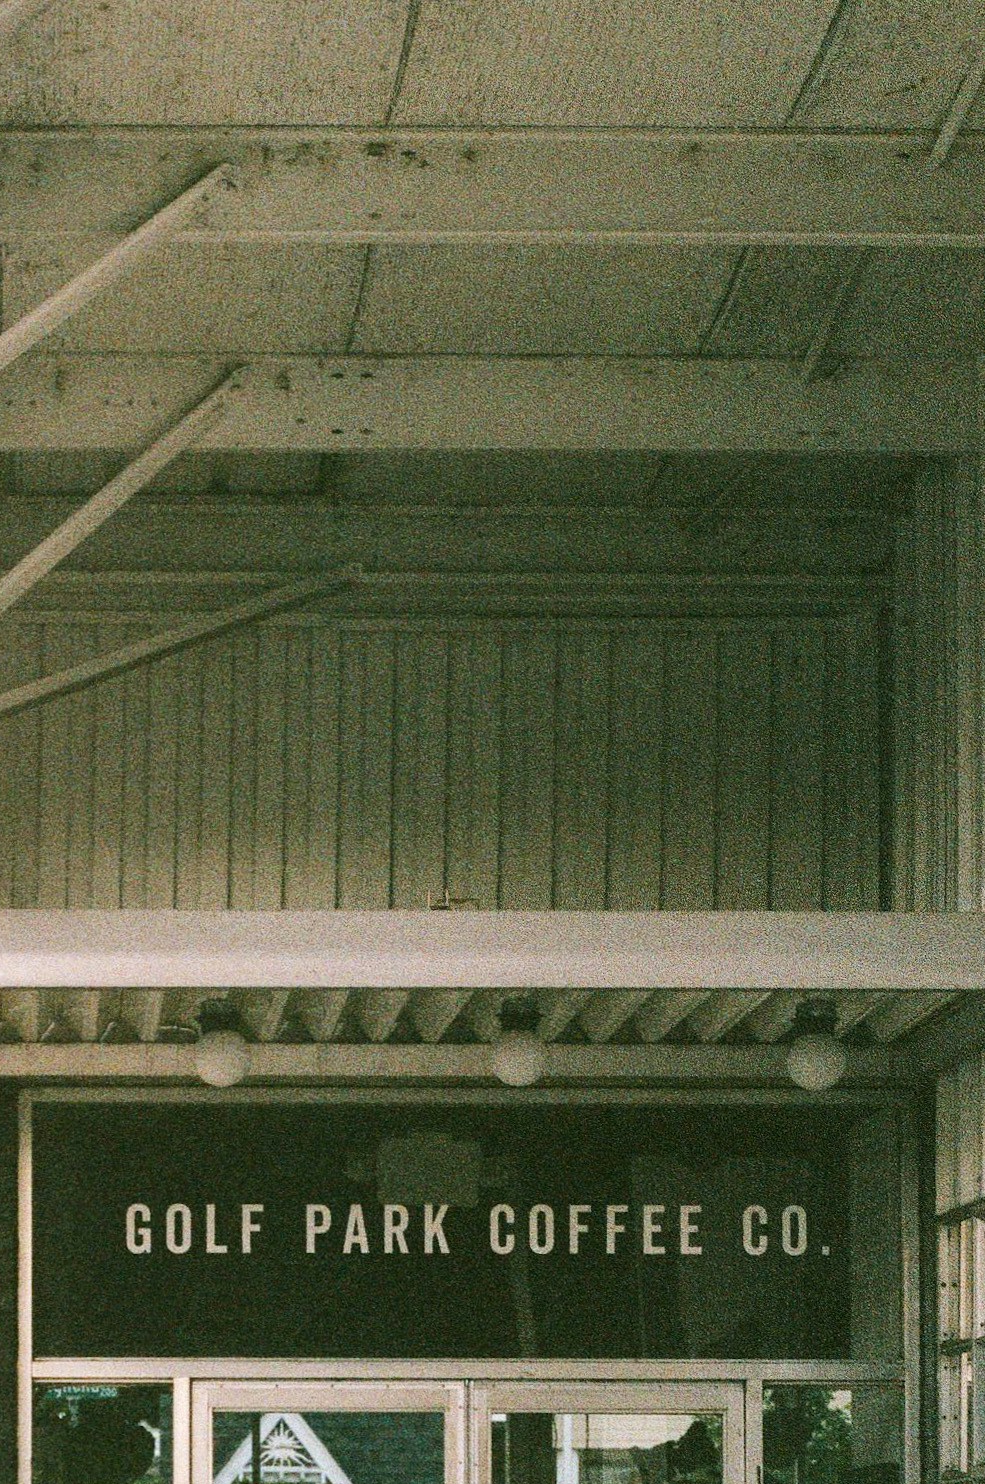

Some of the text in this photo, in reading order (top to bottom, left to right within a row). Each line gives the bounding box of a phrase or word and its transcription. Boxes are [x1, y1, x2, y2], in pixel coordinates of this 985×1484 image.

[125, 1203, 831, 1256] GOLF PARK COFFEE CO.
